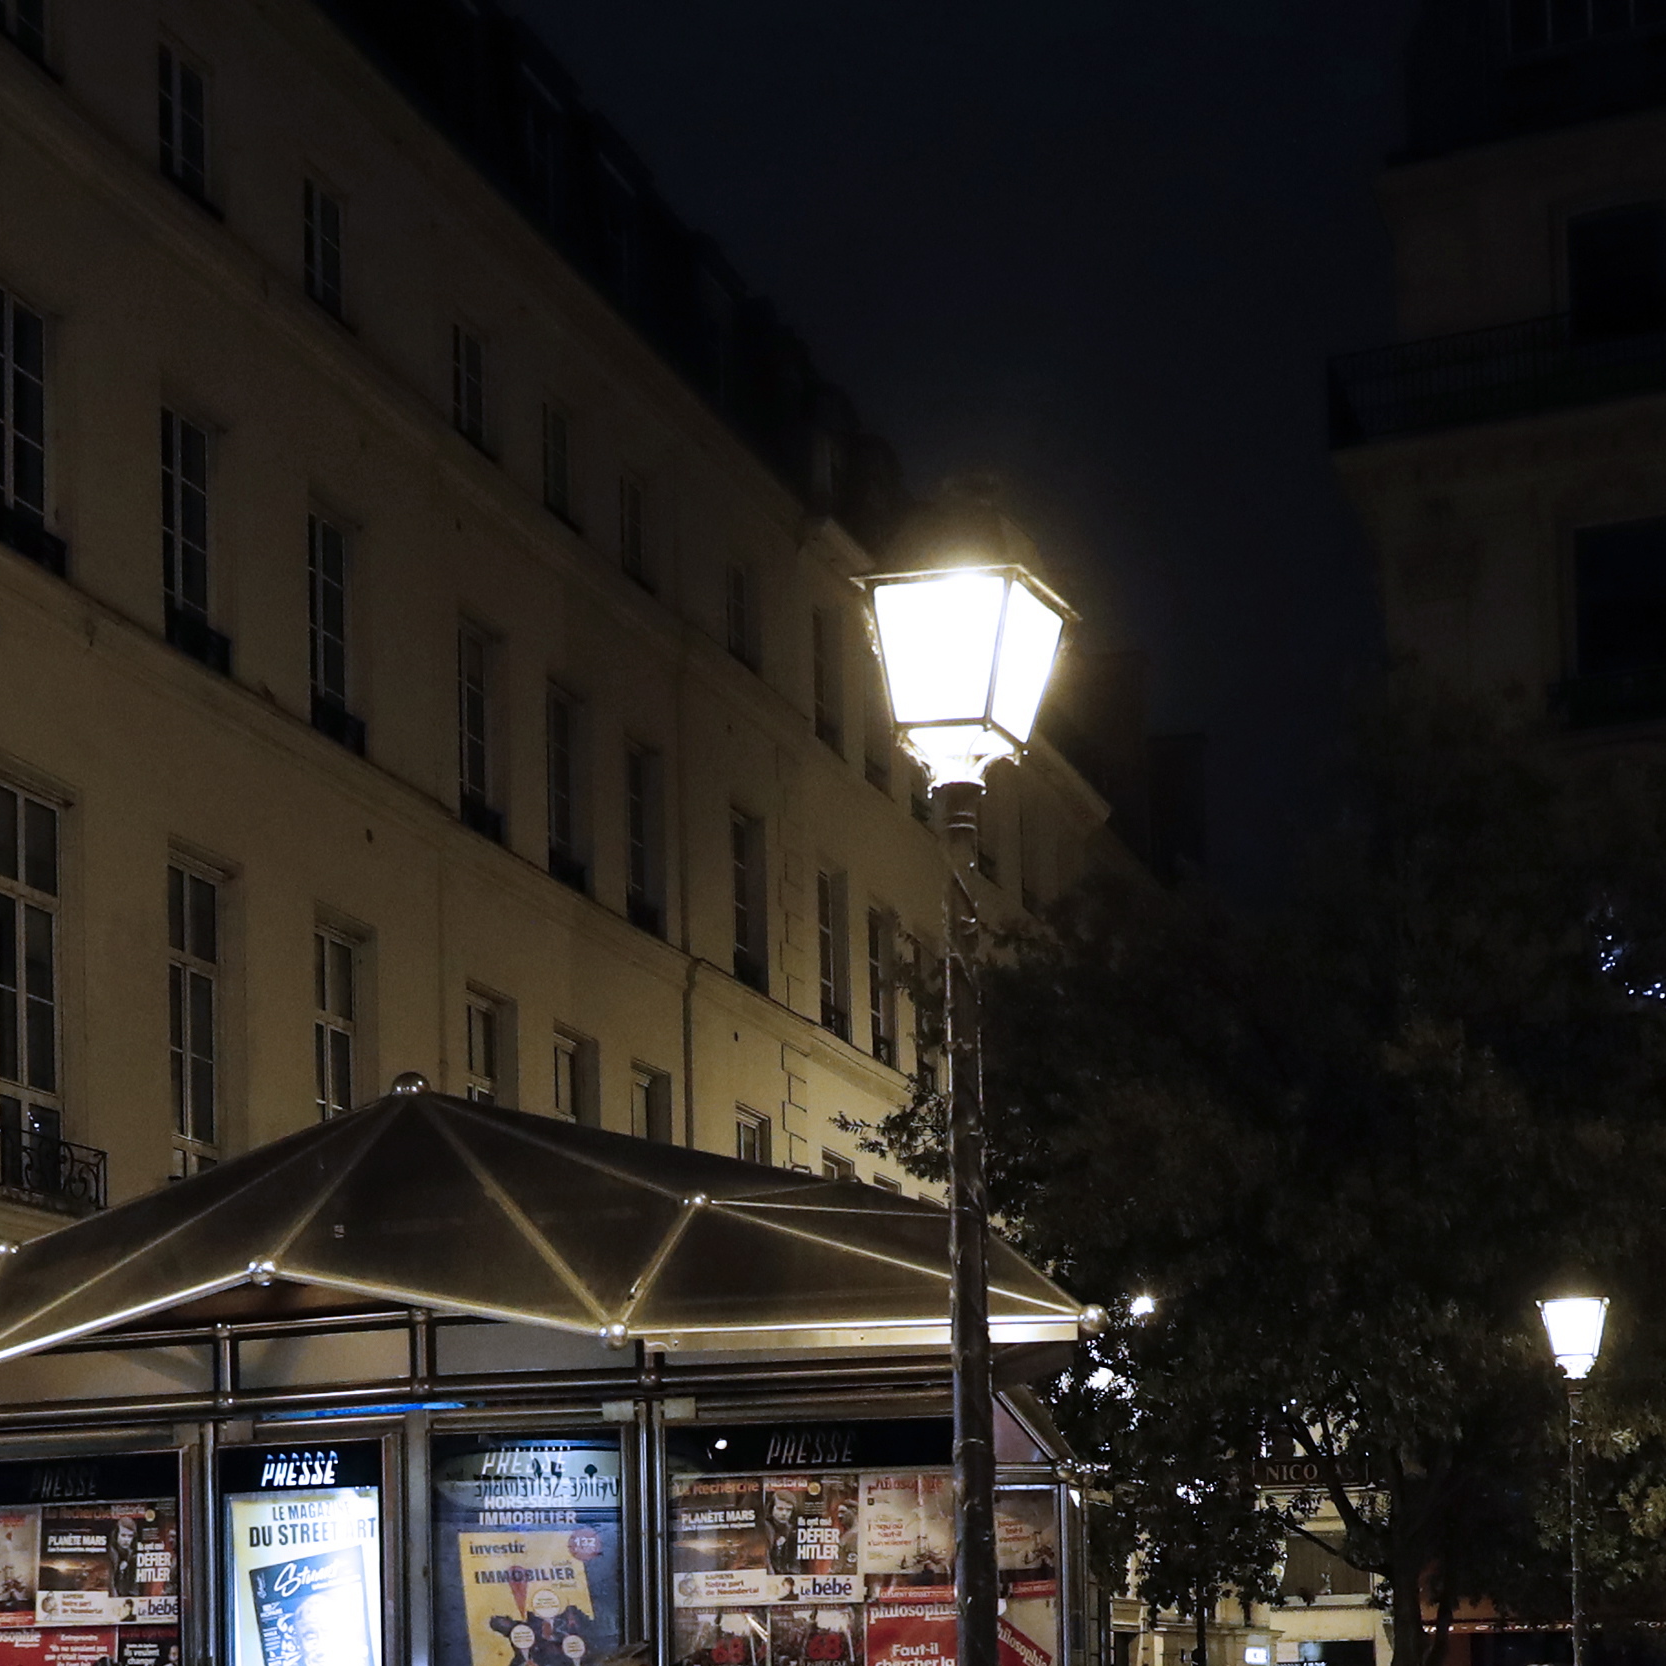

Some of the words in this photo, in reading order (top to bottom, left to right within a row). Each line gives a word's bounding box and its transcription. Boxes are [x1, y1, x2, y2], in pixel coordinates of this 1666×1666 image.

[766, 1433, 858, 1465] PRESSE
[260, 1450, 339, 1488] PRESSE
[481, 1446, 571, 1475] PRESSE
[272, 1506, 285, 1522] LE
[479, 1511, 577, 1526] IMMOBILIER
[681, 1509, 725, 1524] PLANÈTE
[725, 1510, 756, 1521] MARS
[47, 1533, 82, 1547] PLANÈTE
[83, 1536, 107, 1546] MARS
[249, 1525, 272, 1548] DU
[278, 1520, 338, 1546] STREET
[573, 1537, 597, 1548] 132
[798, 1526, 840, 1544] DÉFIER
[470, 1540, 525, 1555] investir
[797, 1544, 839, 1560] HITLER
[136, 1550, 172, 1567] DÉFIER
[136, 1568, 171, 1582] HITLER
[475, 1566, 575, 1585] IMMOBILIER
[800, 1586, 811, 1595] Le
[812, 1577, 852, 1595] bébé
[870, 1603, 958, 1625] philosophie
[712, 1638, 747, 1664] 68
[807, 1634, 843, 1660] 68
[891, 1642, 939, 1658] Faut-il
